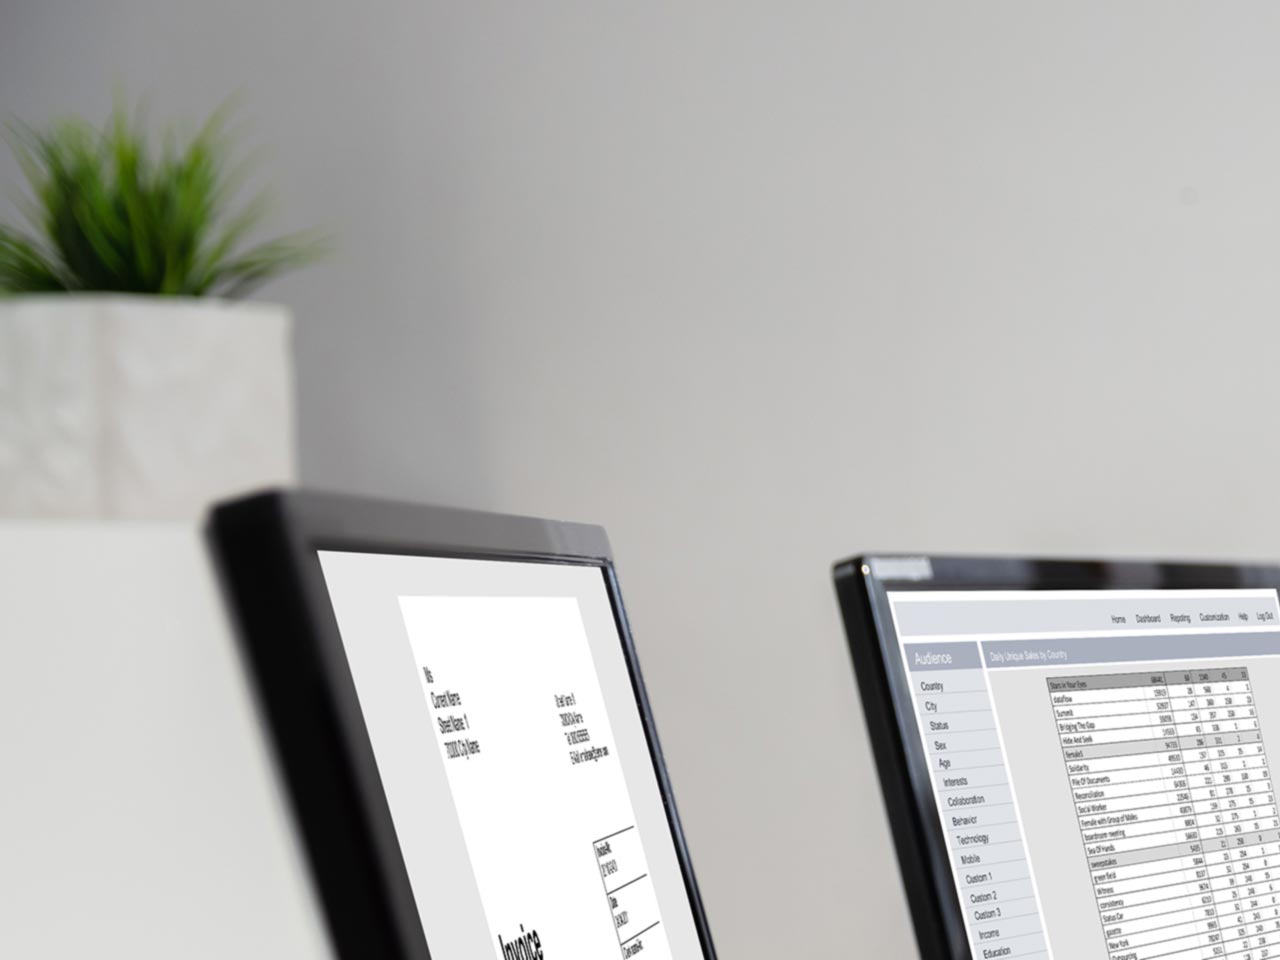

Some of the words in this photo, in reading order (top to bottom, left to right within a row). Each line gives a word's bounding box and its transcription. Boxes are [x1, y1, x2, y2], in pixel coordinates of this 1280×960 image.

[1111, 616, 1126, 624] Home
[1135, 614, 1161, 623] Dashboard
[1170, 613, 1191, 624] Reporting
[1199, 613, 1230, 622] Customization
[1238, 613, 1248, 621] Help
[1256, 612, 1266, 622] Log
[1265, 611, 1274, 620] Out
[915, 652, 952, 665] Audience
[920, 681, 944, 693] Country
[925, 701, 937, 713] City
[929, 721, 949, 731] Status
[934, 741, 947, 751] Sex
[939, 758, 951, 769] Age
[943, 777, 968, 787] Interests
[947, 795, 985, 807] Collaboration
[952, 816, 977, 827] Behavior
[956, 834, 989, 845] Technology
[960, 854, 980, 865] Mobile
[965, 874, 988, 884] Custom
[988, 872, 992, 880] 1
[970, 893, 992, 904] Custom
[992, 891, 997, 900] 2
[974, 910, 996, 921] Custom
[996, 907, 1001, 917] 3
[978, 929, 1000, 940] Income
[498, 923, 544, 960] Invoice
[983, 947, 1011, 959] Education
